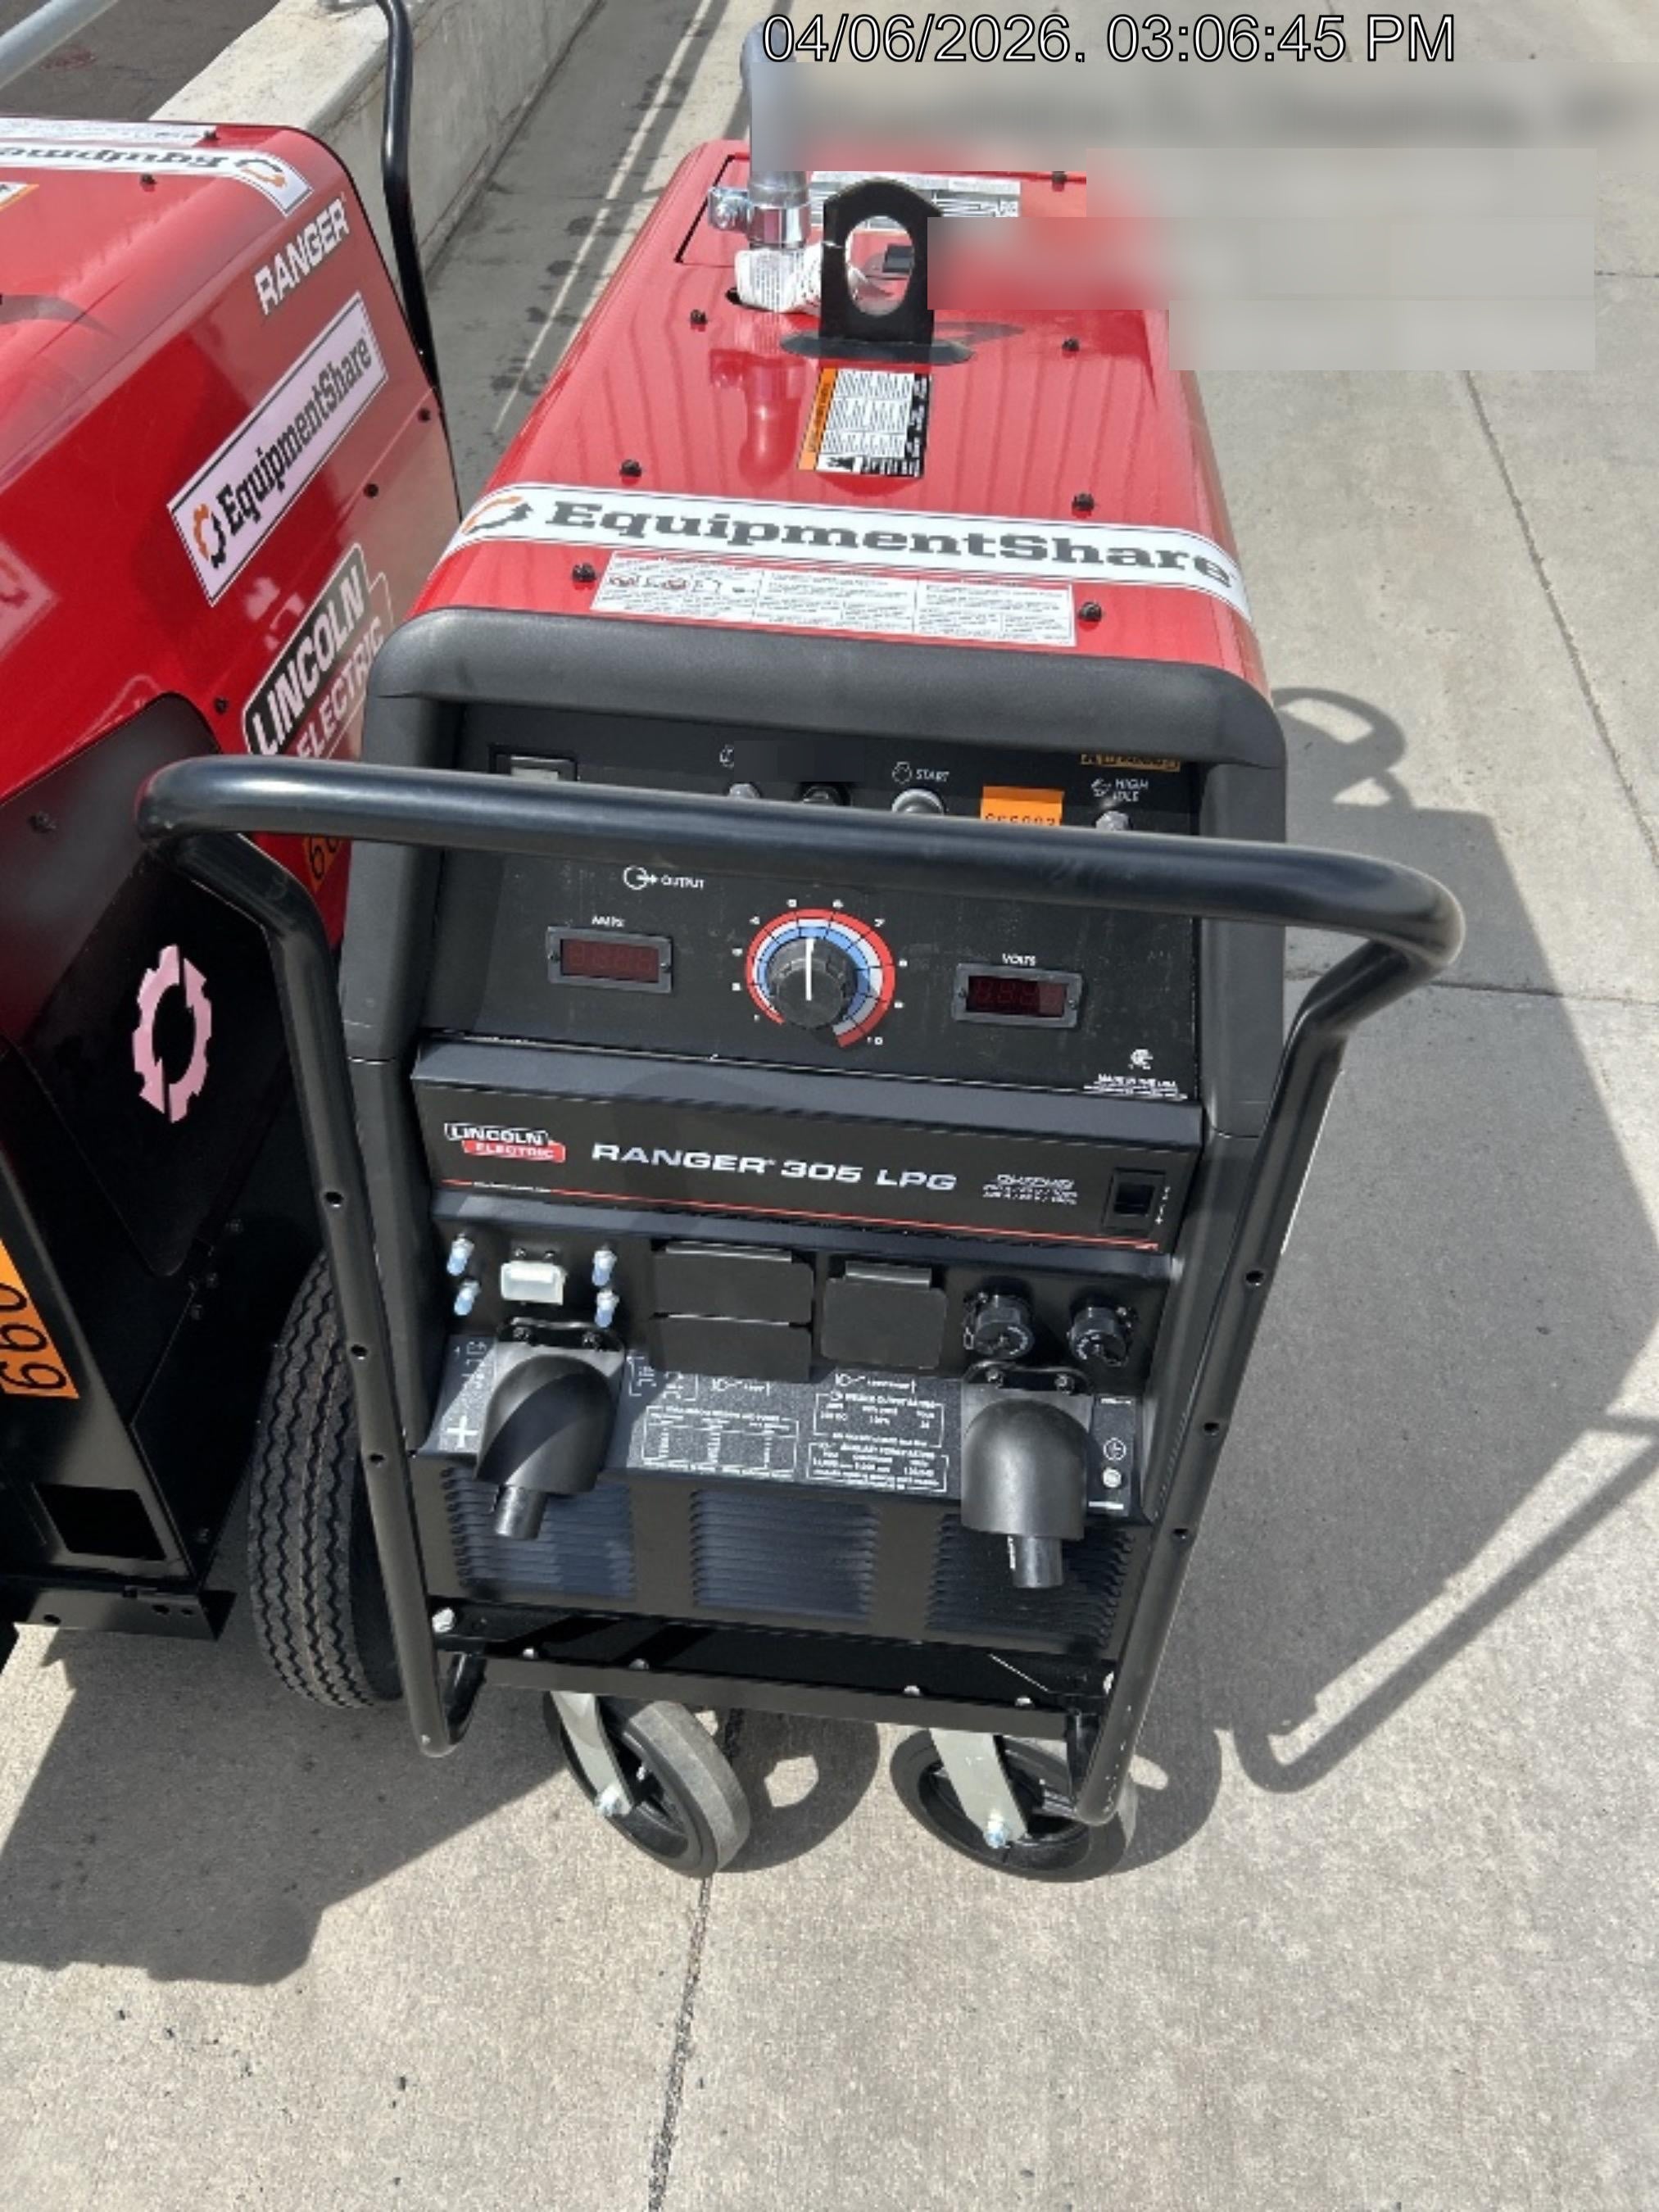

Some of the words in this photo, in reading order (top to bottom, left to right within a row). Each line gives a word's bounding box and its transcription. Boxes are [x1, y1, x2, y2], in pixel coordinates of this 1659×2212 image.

[254, 197, 350, 315] RANGER
[215, 338, 372, 537] EquipmentShare
[545, 499, 1235, 588] EquipmentShare
[252, 565, 365, 756] LINCOLN
[297, 616, 384, 759] ELECTRIC
[915, 768, 950, 782] START
[660, 874, 705, 890] OUTPUT
[1001, 953, 1036, 966] VOLTS
[451, 1126, 542, 1145] LINCOLN
[475, 1143, 555, 1159] ELECTRIC
[780, 1159, 863, 1184] 305
[875, 1167, 958, 1191] LPG
